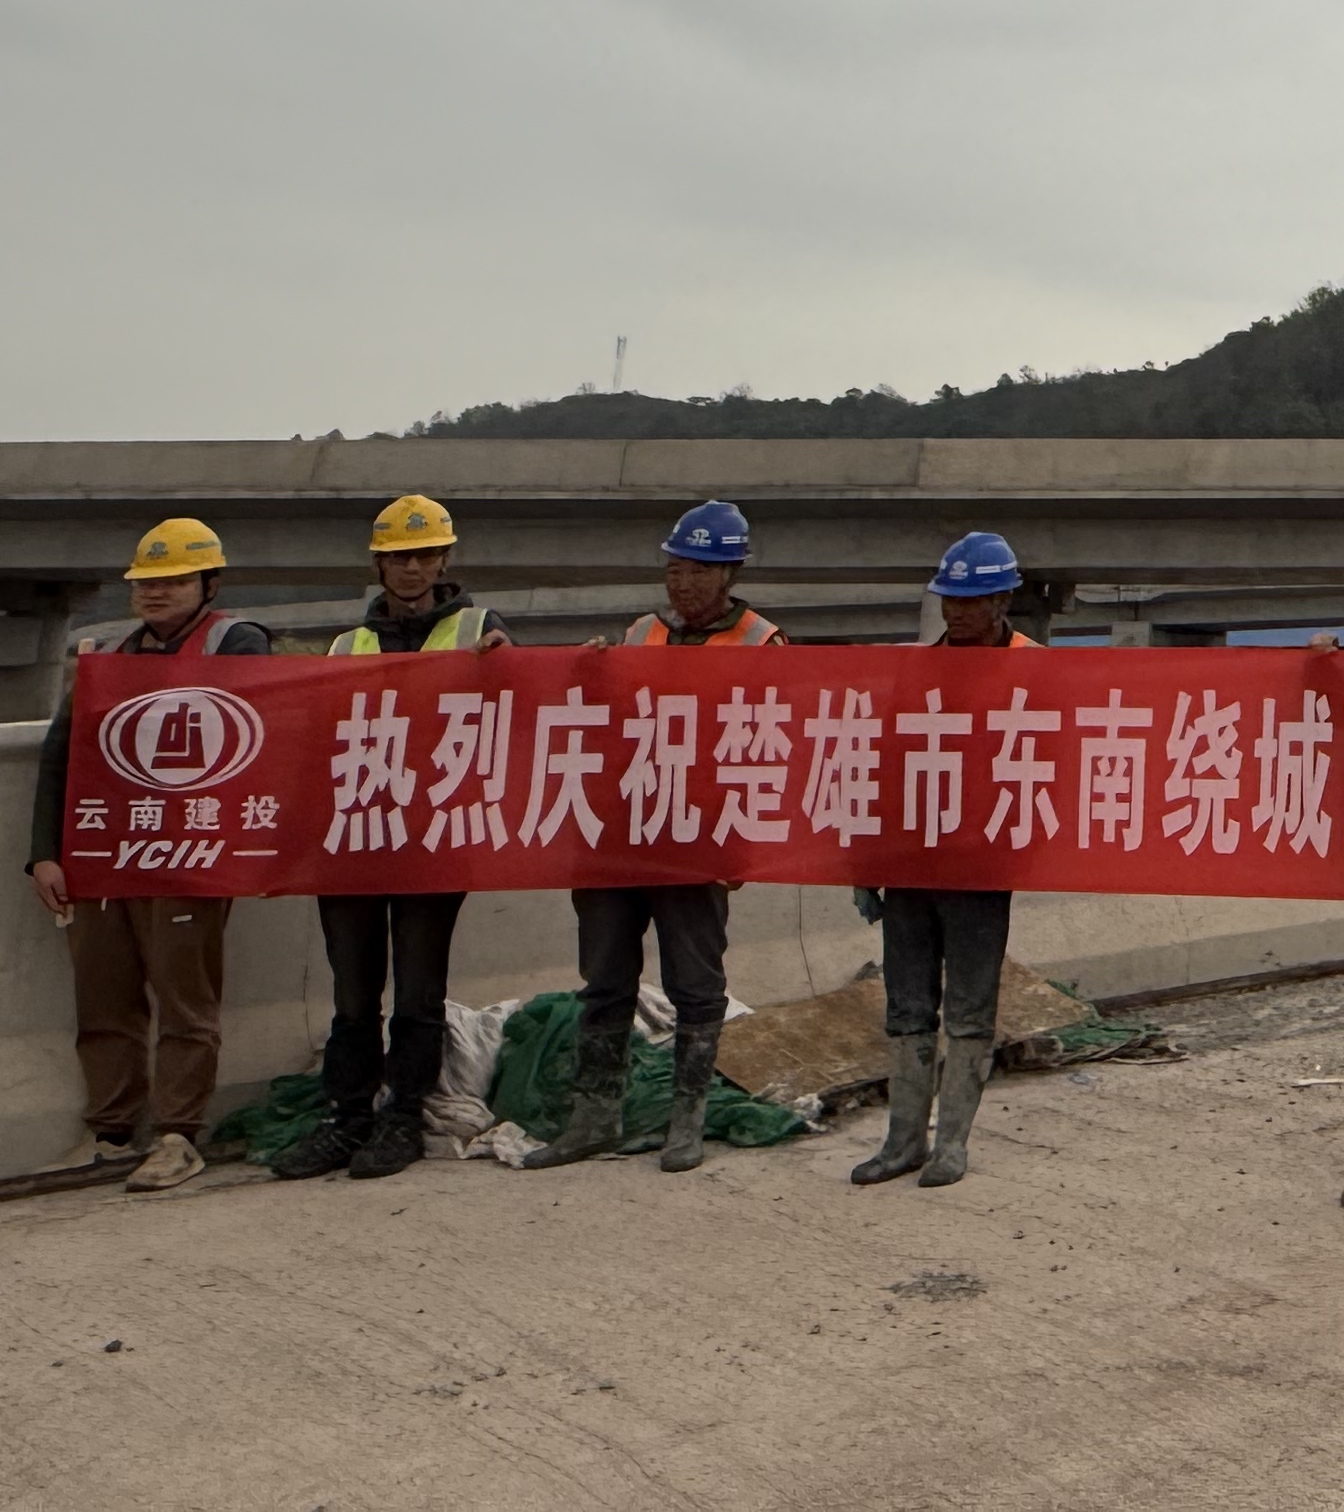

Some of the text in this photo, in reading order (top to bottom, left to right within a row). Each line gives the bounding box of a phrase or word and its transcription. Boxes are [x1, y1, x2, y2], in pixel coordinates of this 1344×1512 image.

[75, 795, 280, 831] 云南建投
[113, 839, 226, 870] YCIH
